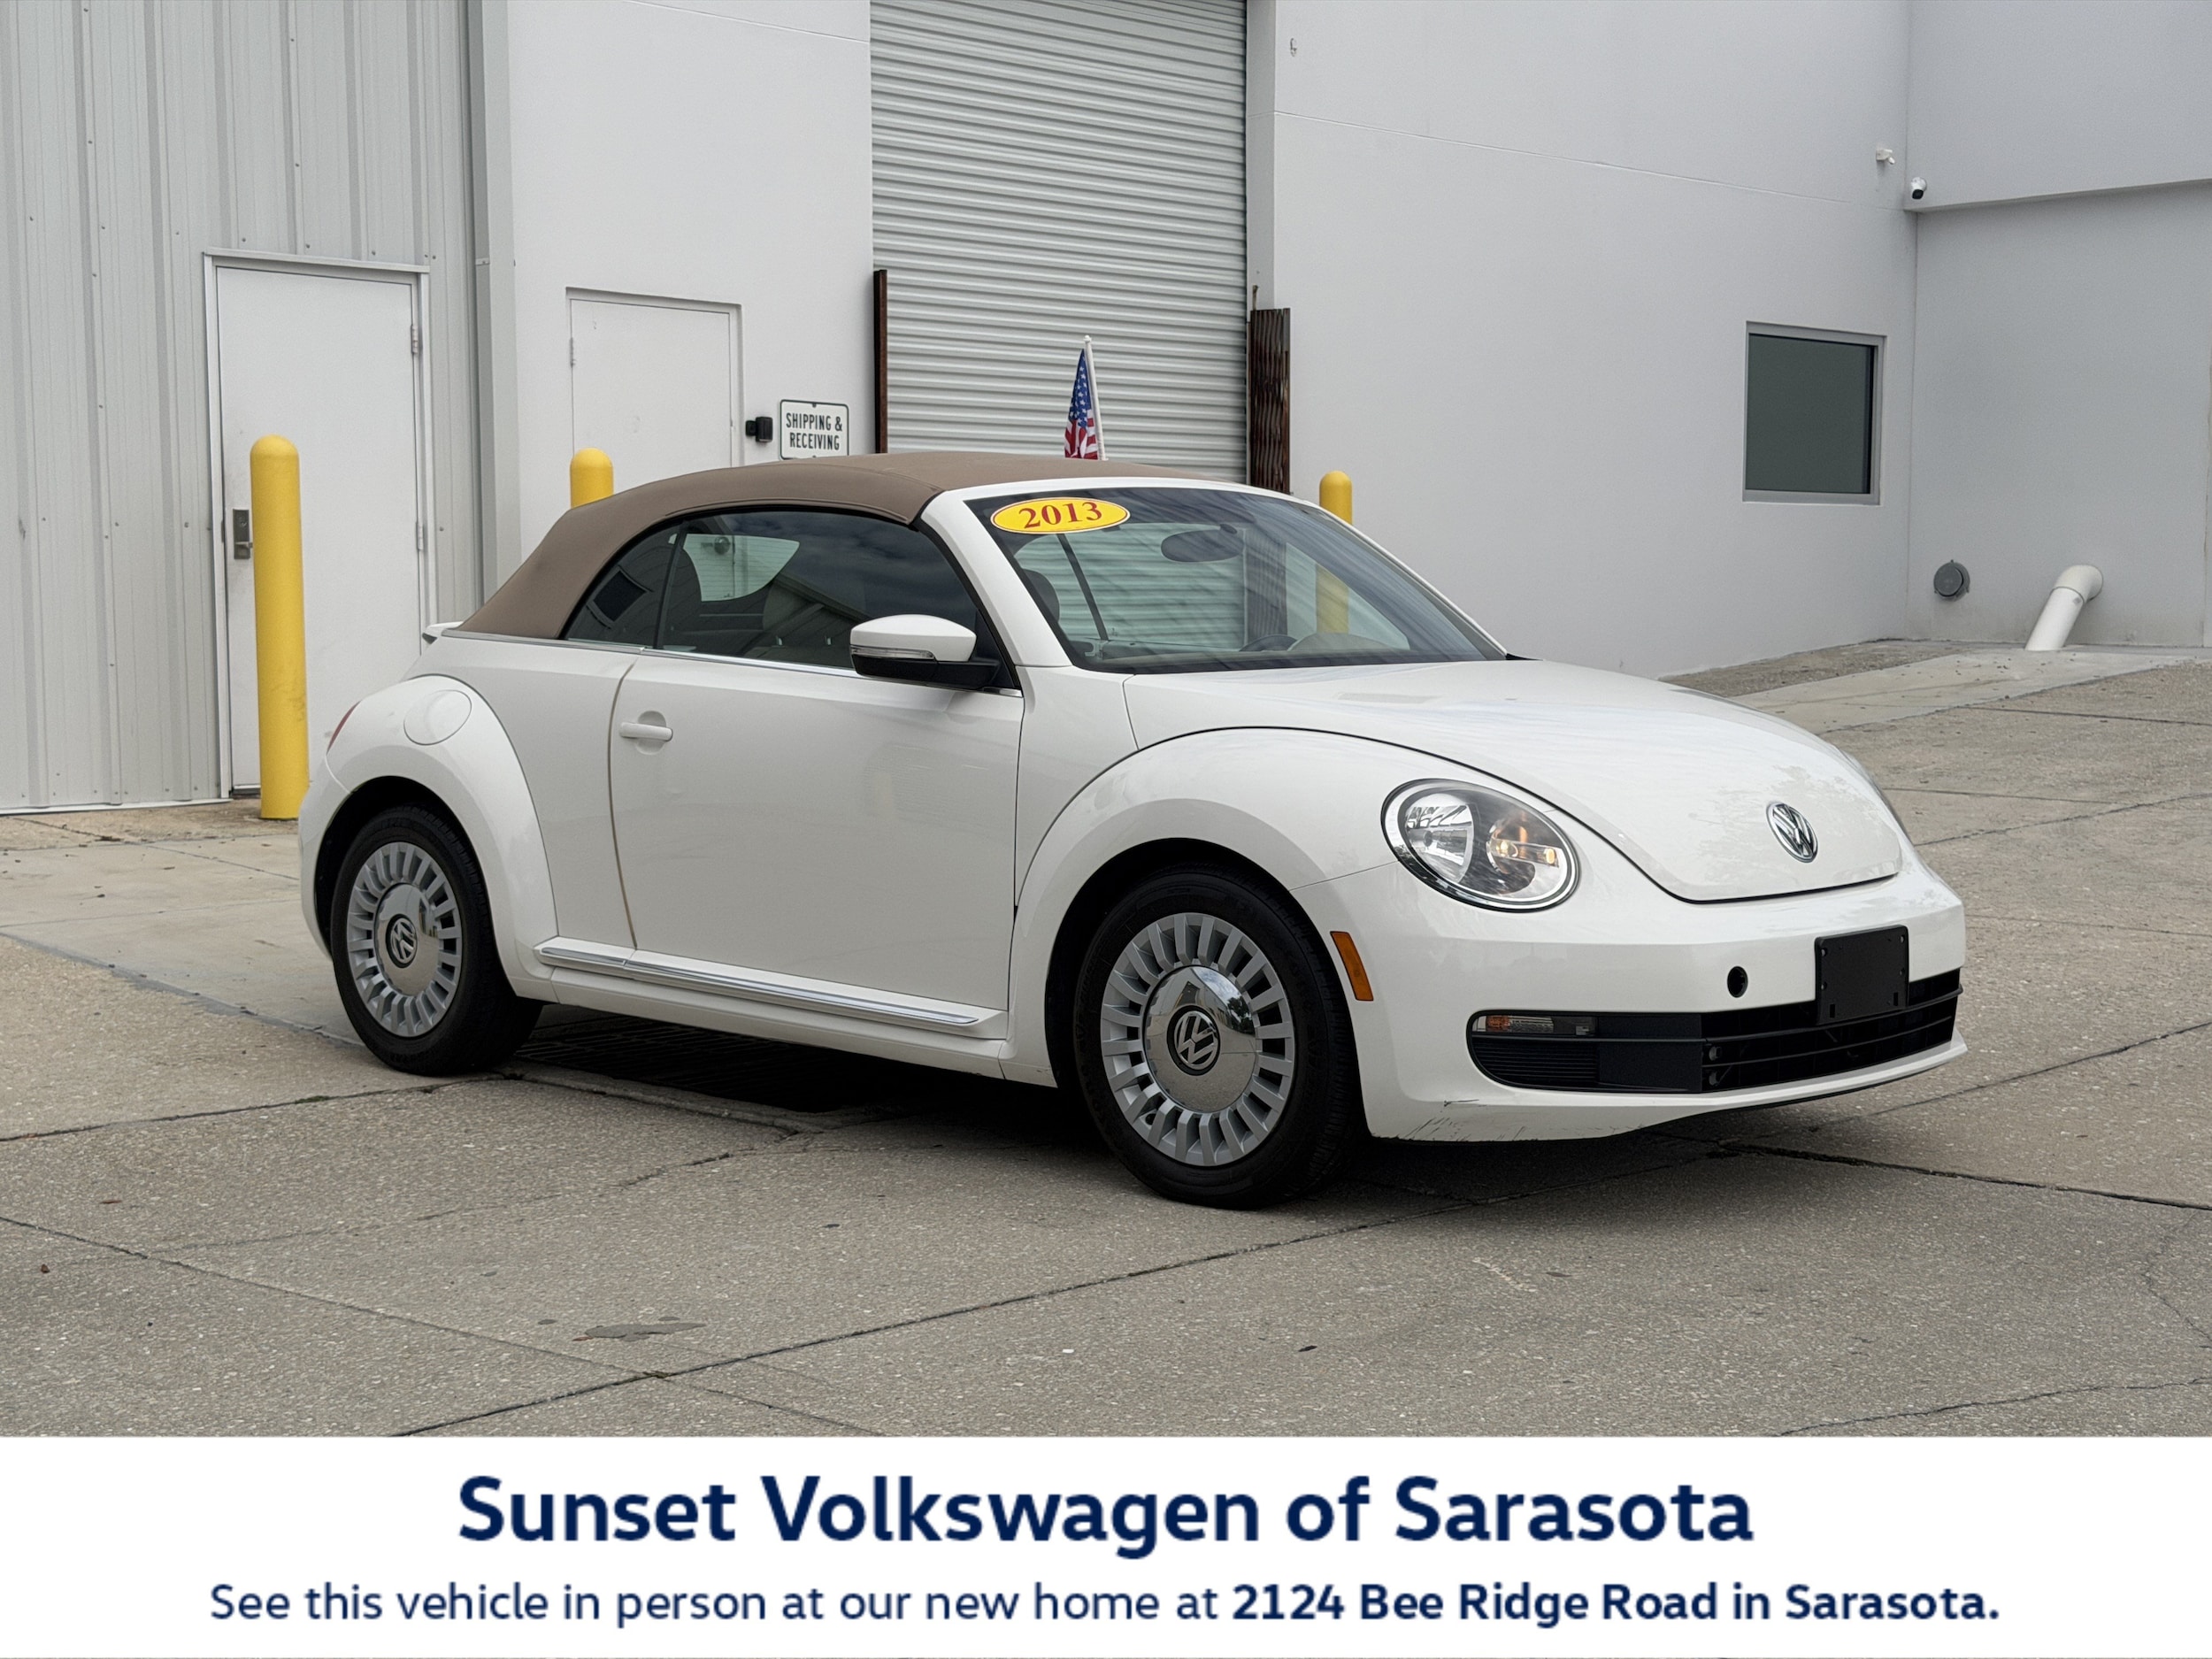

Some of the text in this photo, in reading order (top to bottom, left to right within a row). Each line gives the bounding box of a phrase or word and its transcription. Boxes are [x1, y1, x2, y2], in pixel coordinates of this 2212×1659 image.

[786, 412, 843, 432] SHIPPING &
[789, 432, 840, 450] RECEIVING
[1018, 502, 1102, 529] 2013
